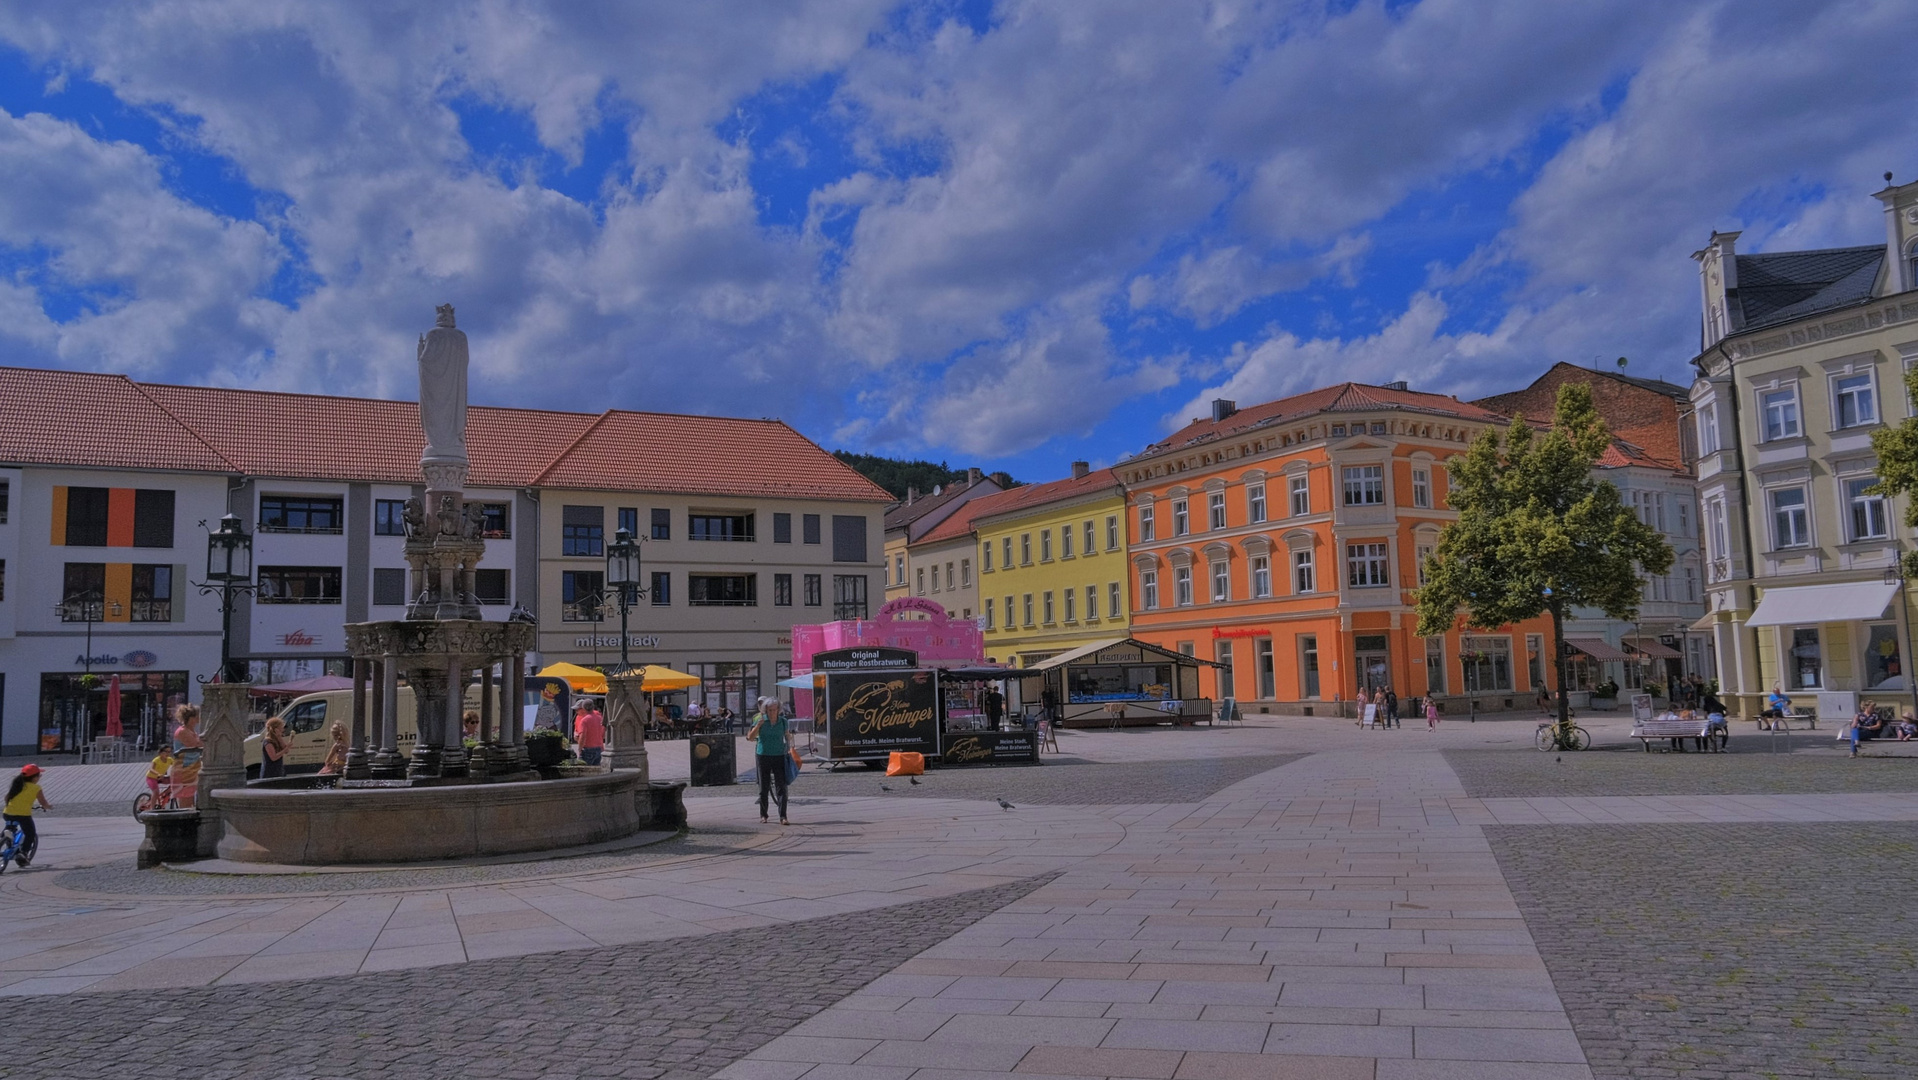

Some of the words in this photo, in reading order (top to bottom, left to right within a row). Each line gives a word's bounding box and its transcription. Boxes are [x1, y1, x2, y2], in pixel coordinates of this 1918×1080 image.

[284, 628, 313, 645] Viba
[75, 654, 118, 664] Apollo
[851, 650, 879, 660] Original
[823, 660, 857, 669] Thüringer
[858, 659, 908, 667] Rostbratwurst
[890, 700, 911, 711] Meine
[858, 706, 933, 734] Meininger
[957, 748, 992, 762] Meininger
